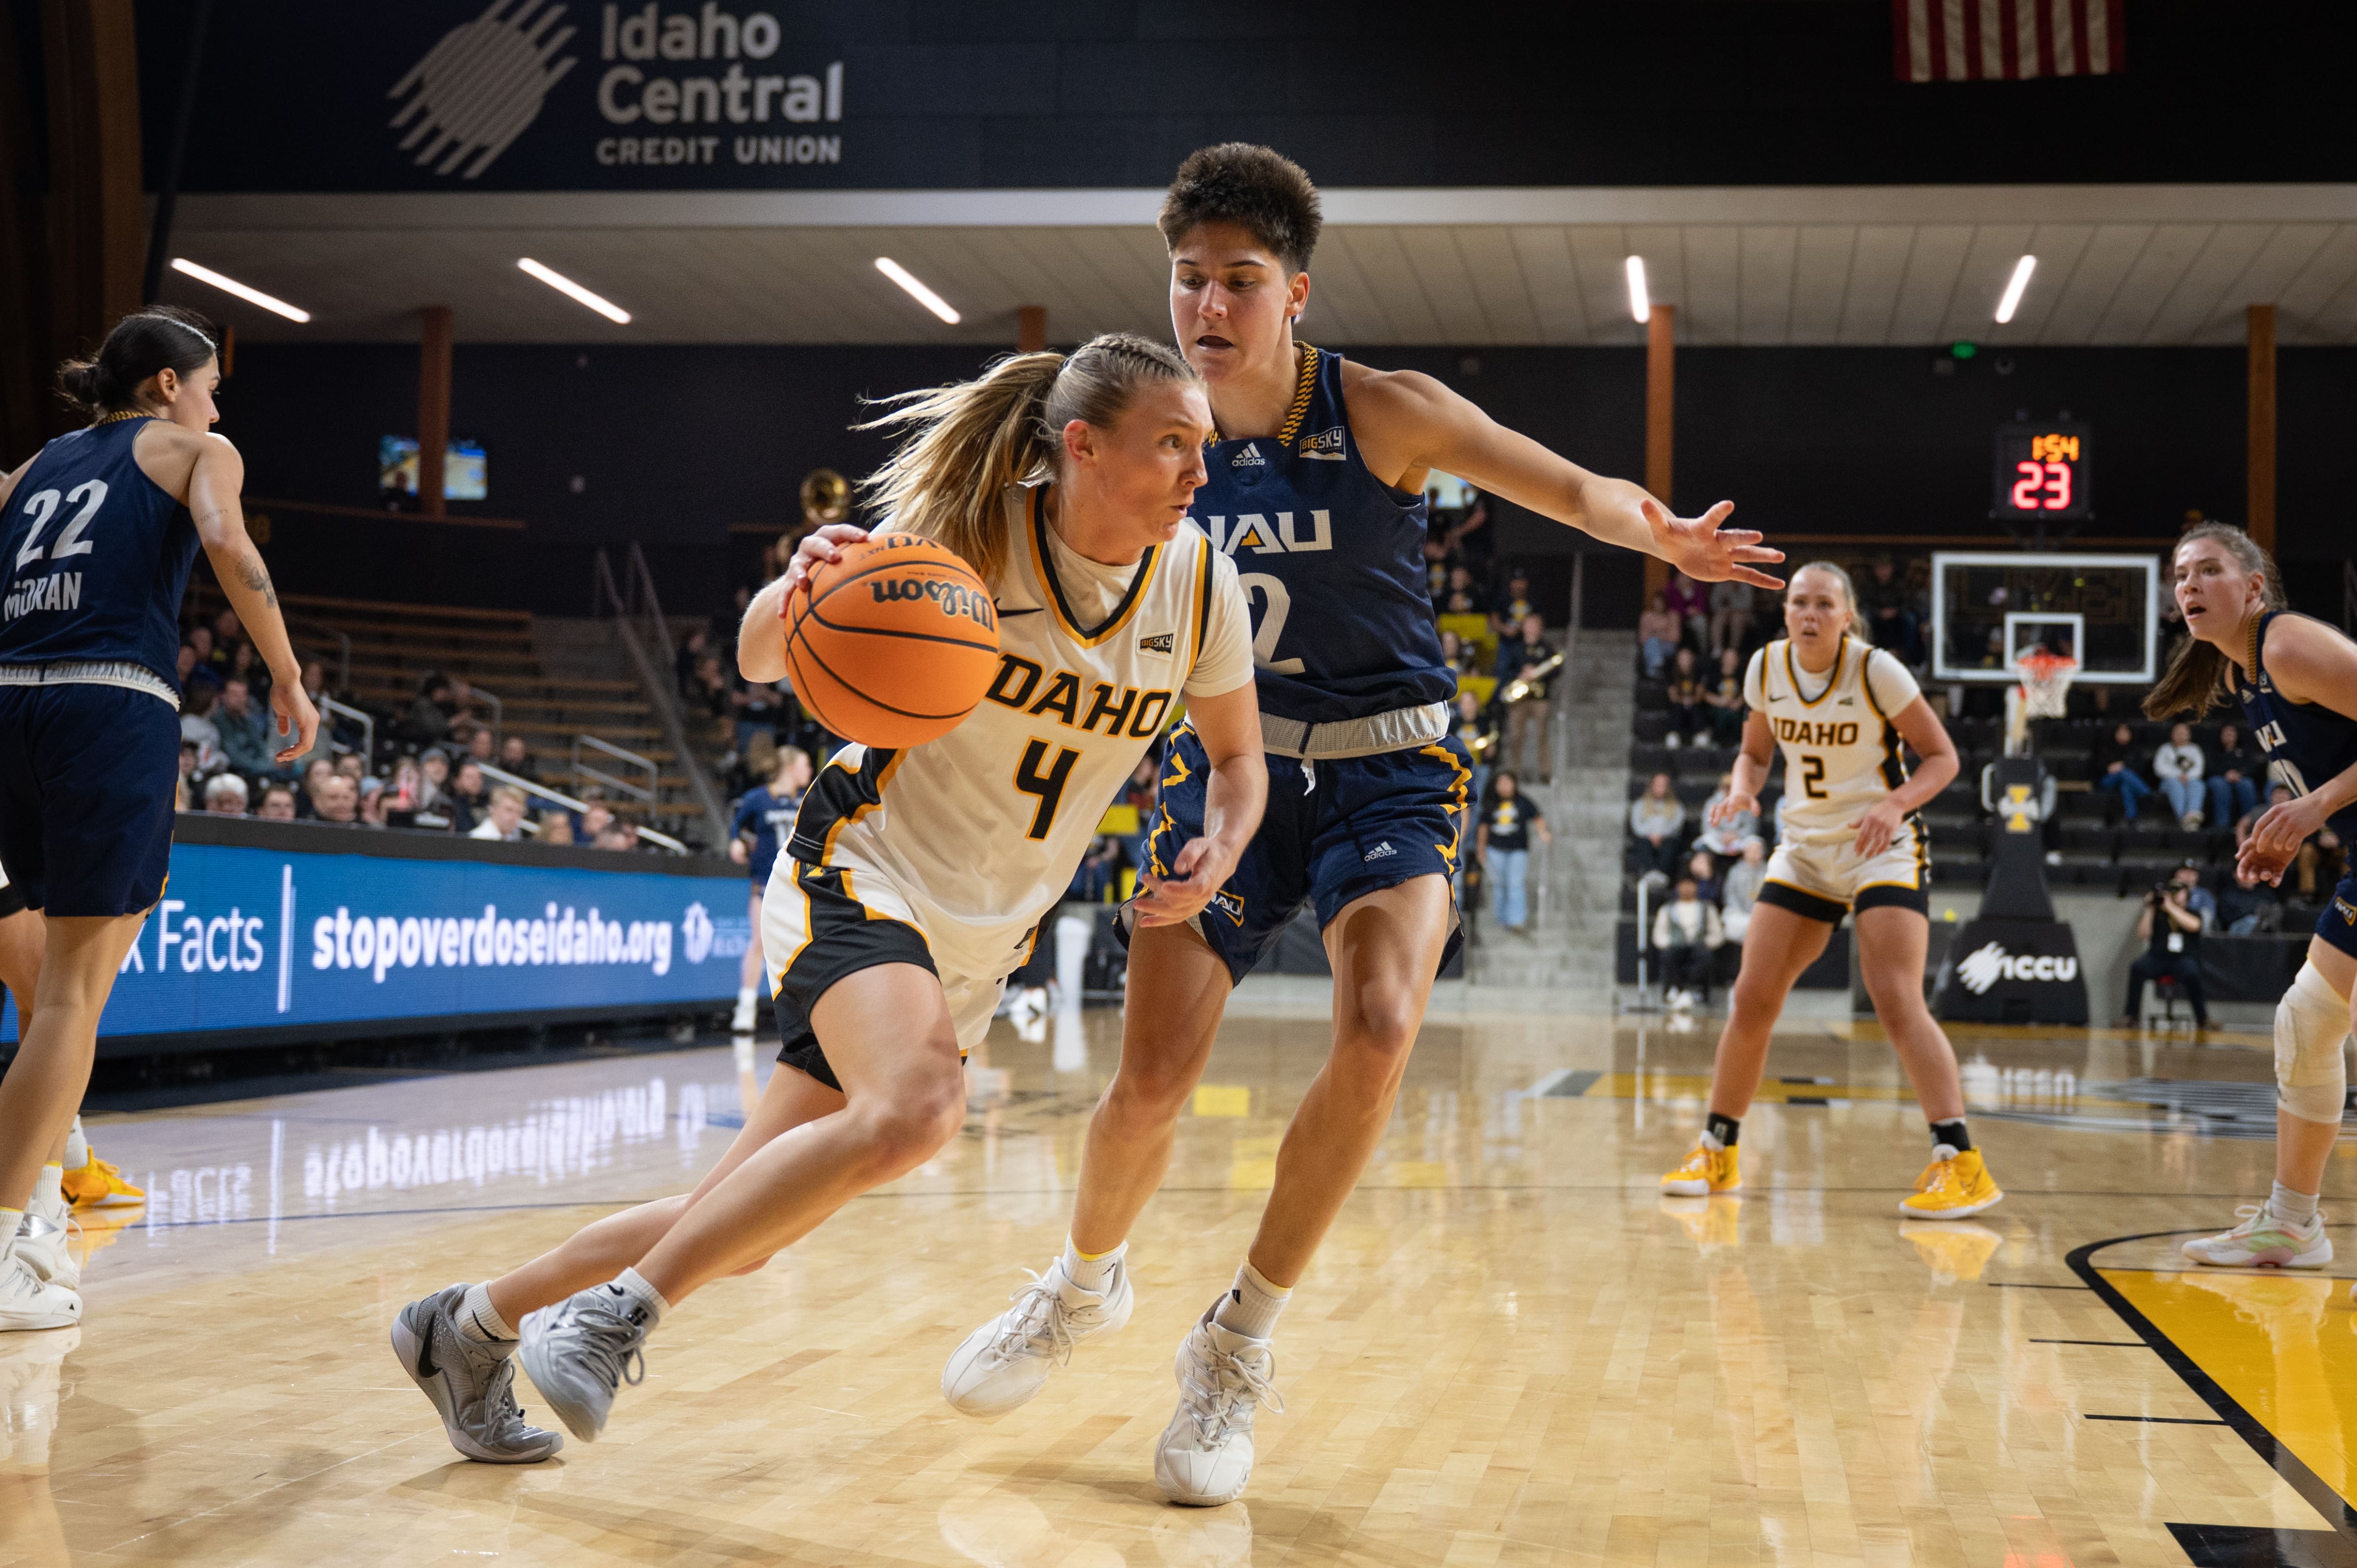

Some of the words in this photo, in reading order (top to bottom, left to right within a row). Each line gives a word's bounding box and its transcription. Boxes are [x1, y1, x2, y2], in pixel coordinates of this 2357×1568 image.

[601, 1, 781, 60] Idaho
[597, 61, 844, 124] Central
[596, 136, 719, 165] CREDIT
[734, 135, 841, 165] UNION
[1232, 457, 1265, 467] adidas
[2013, 461, 2072, 510] 23
[16, 479, 109, 572] 22
[1181, 509, 1333, 556] NAU
[4, 572, 82, 622] MORAN
[869, 578, 995, 635] Wilson
[984, 650, 1174, 740] DAHO
[1773, 716, 1859, 747] IDAHO
[1011, 735, 1085, 842] 4
[1801, 753, 1829, 800] 2
[1364, 849, 1397, 862] adidas
[1211, 894, 1241, 916] AU
[158, 899, 264, 972] Facts
[312, 901, 672, 983] stopoverdoseidaho.org
